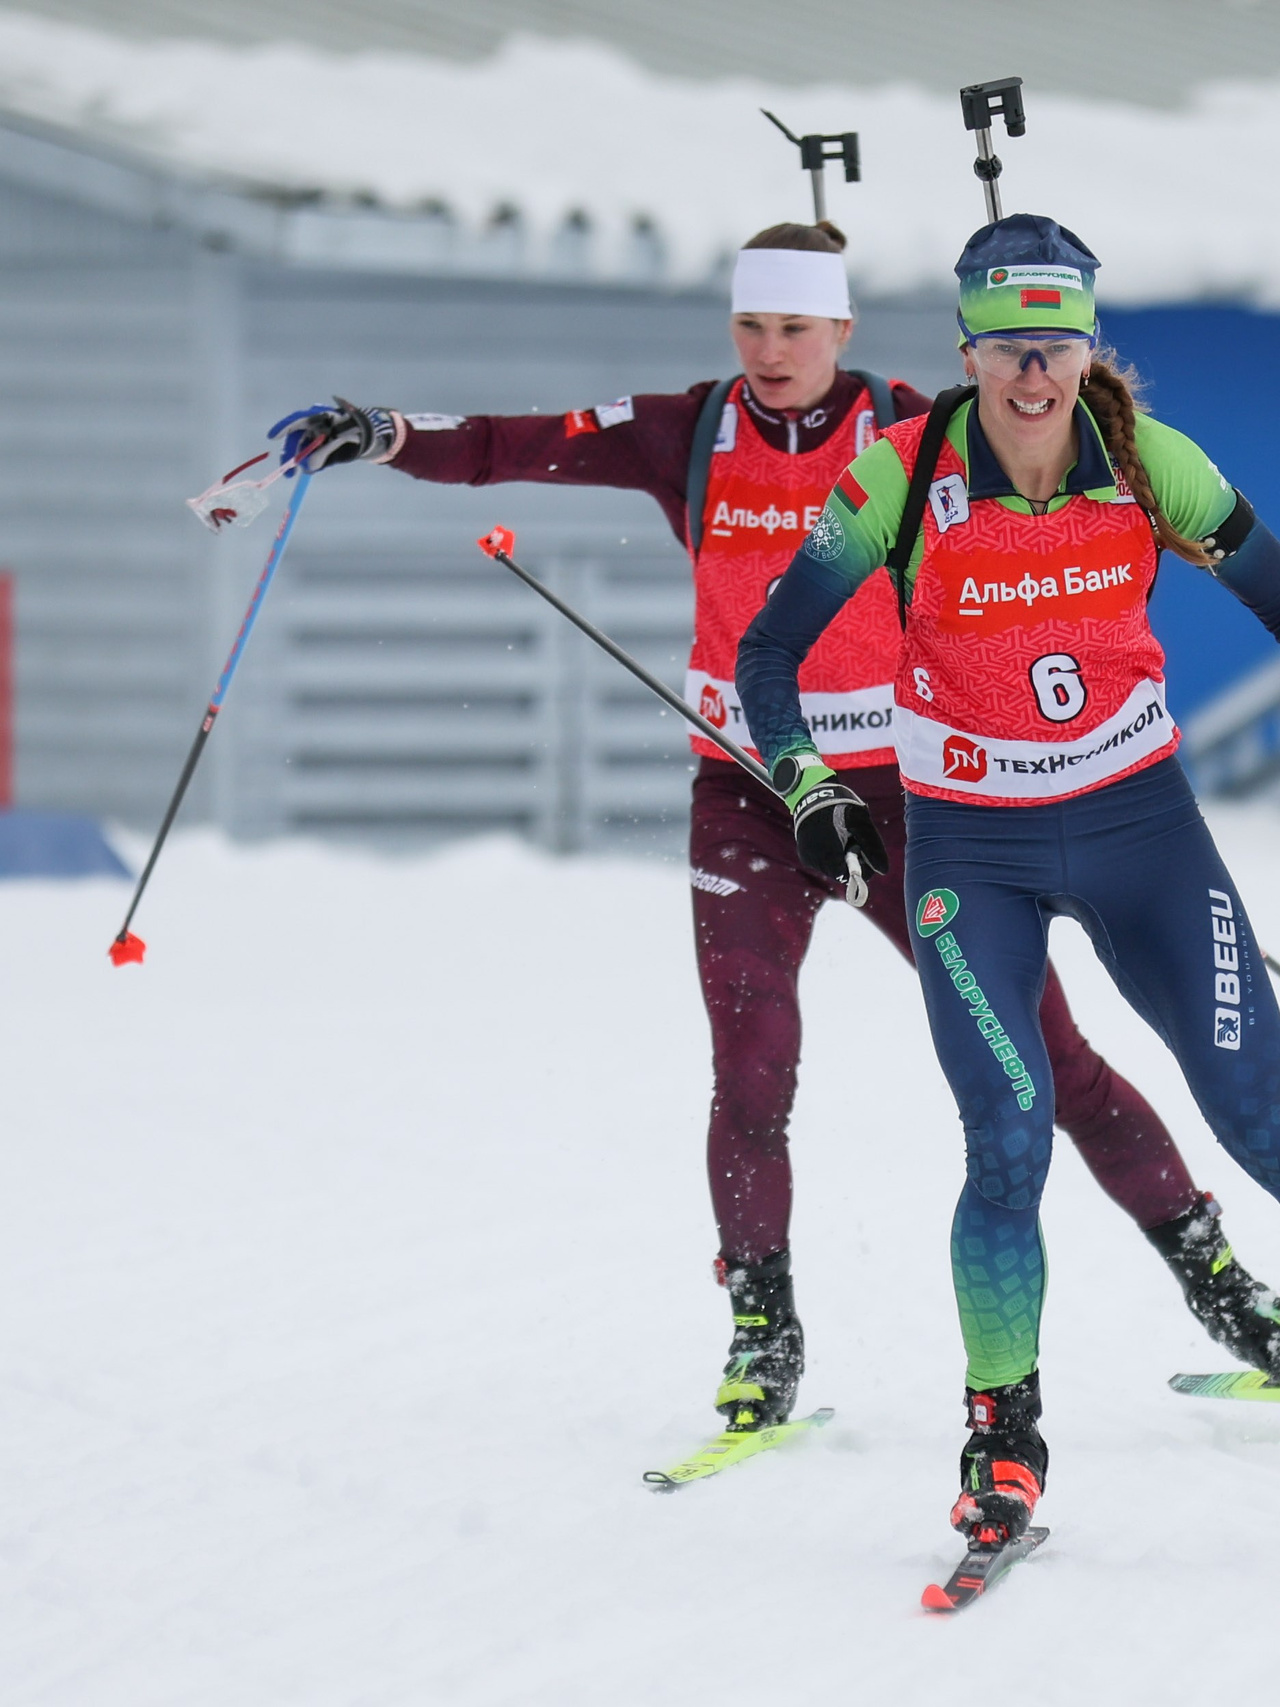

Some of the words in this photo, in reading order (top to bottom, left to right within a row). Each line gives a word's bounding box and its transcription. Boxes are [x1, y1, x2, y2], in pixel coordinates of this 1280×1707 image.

[712, 501, 798, 536] Альфа
[958, 572, 1059, 609] Альфа
[1063, 563, 1133, 595] Банк
[912, 666, 934, 703] 6
[1029, 653, 1087, 723] 6
[993, 700, 1164, 775] ТЕХНОНИКОЛ
[1208, 888, 1241, 1005] BEEU
[935, 931, 1036, 1111] БЕЛОРУСНЕФТЬ
